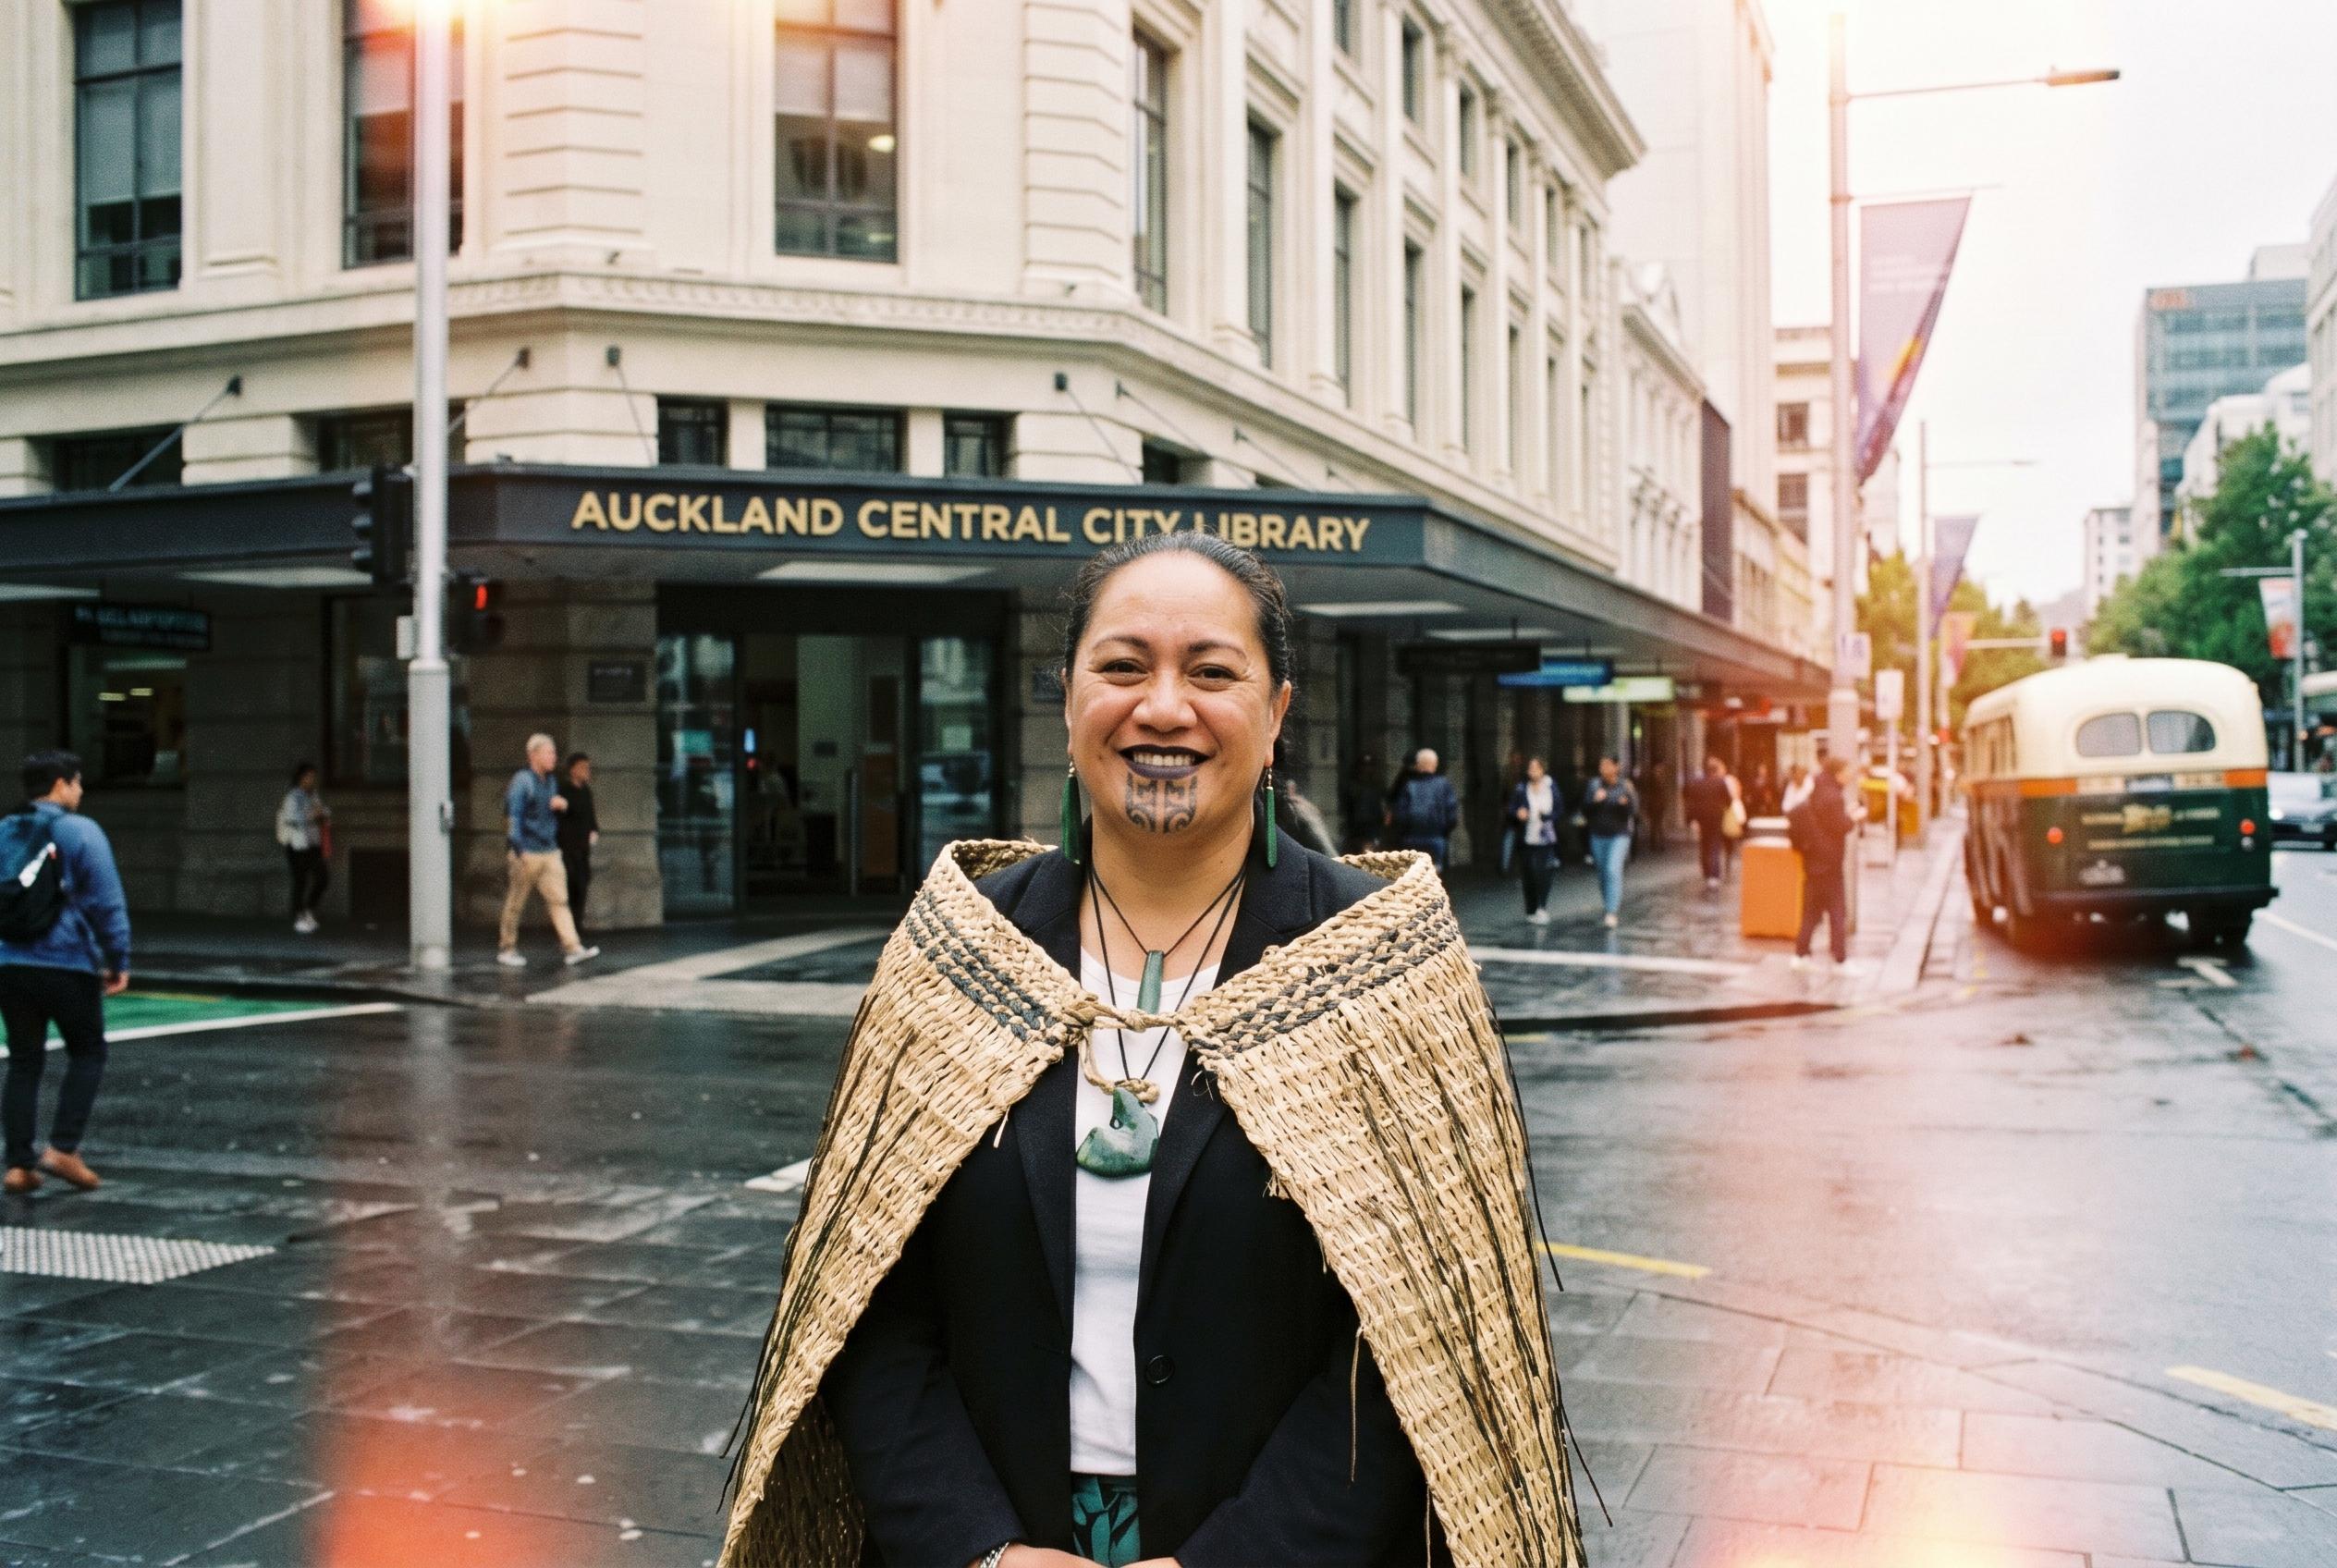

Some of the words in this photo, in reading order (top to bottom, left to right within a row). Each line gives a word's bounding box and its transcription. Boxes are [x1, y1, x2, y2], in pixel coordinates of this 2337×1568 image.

[570, 490, 845, 535] AUCKLAND
[856, 499, 1071, 543] CENTRAL
[1083, 508, 1181, 545] CITY
